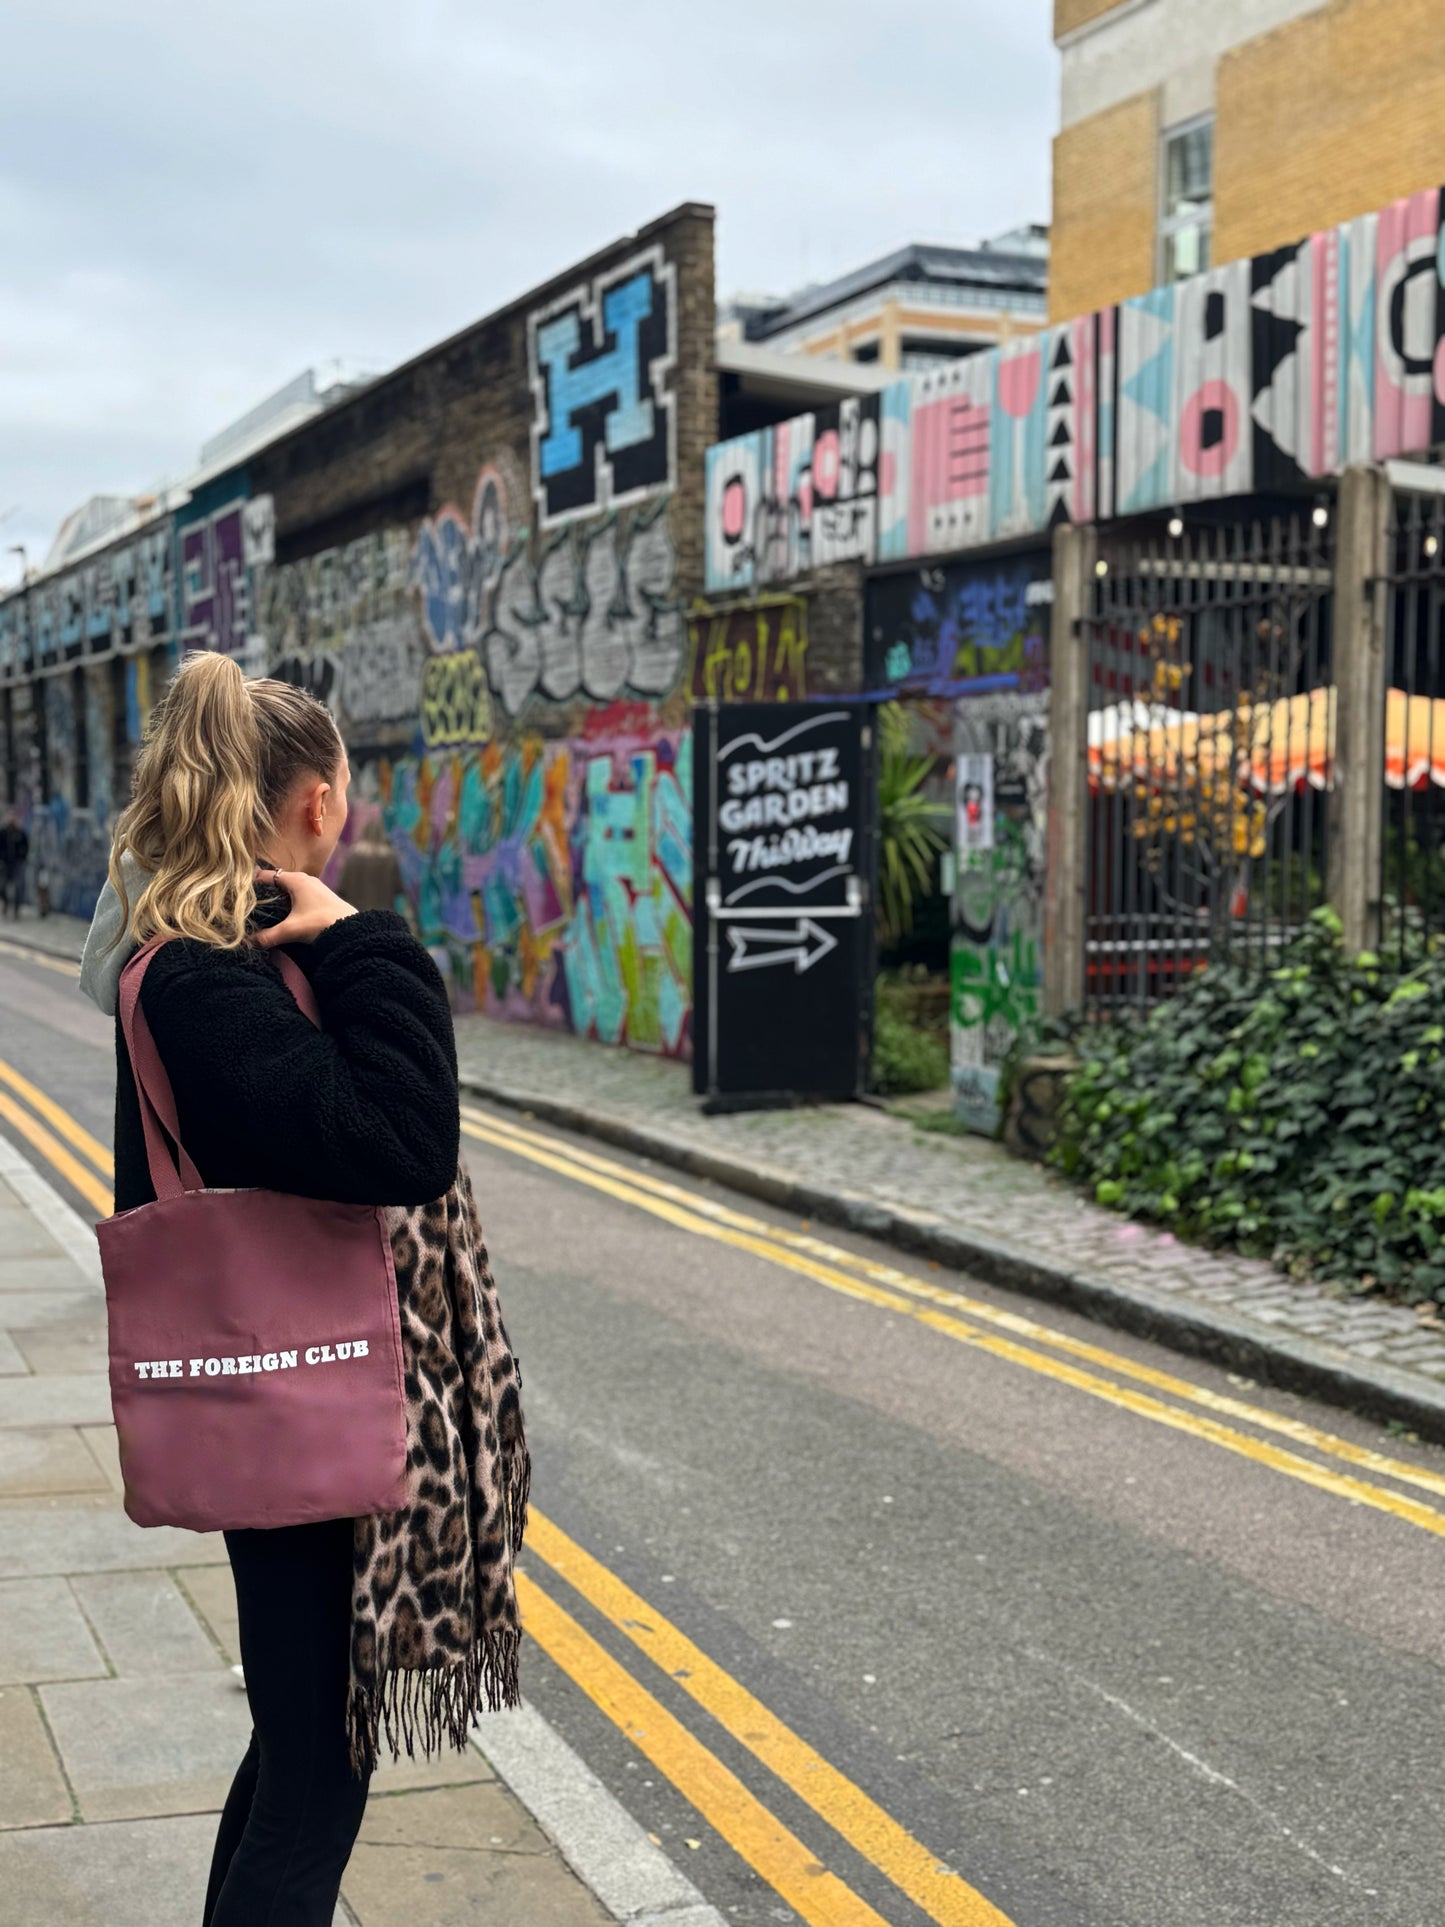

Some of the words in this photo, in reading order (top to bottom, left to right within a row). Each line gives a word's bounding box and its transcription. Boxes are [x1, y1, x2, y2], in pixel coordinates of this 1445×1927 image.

[536, 268, 668, 516] H
[728, 748, 840, 795] SPRITZ
[720, 781, 849, 833] GARDEN
[134, 1360, 183, 1379] THE
[189, 1350, 298, 1377] FOREIGN
[305, 1340, 369, 1365] CLUB
